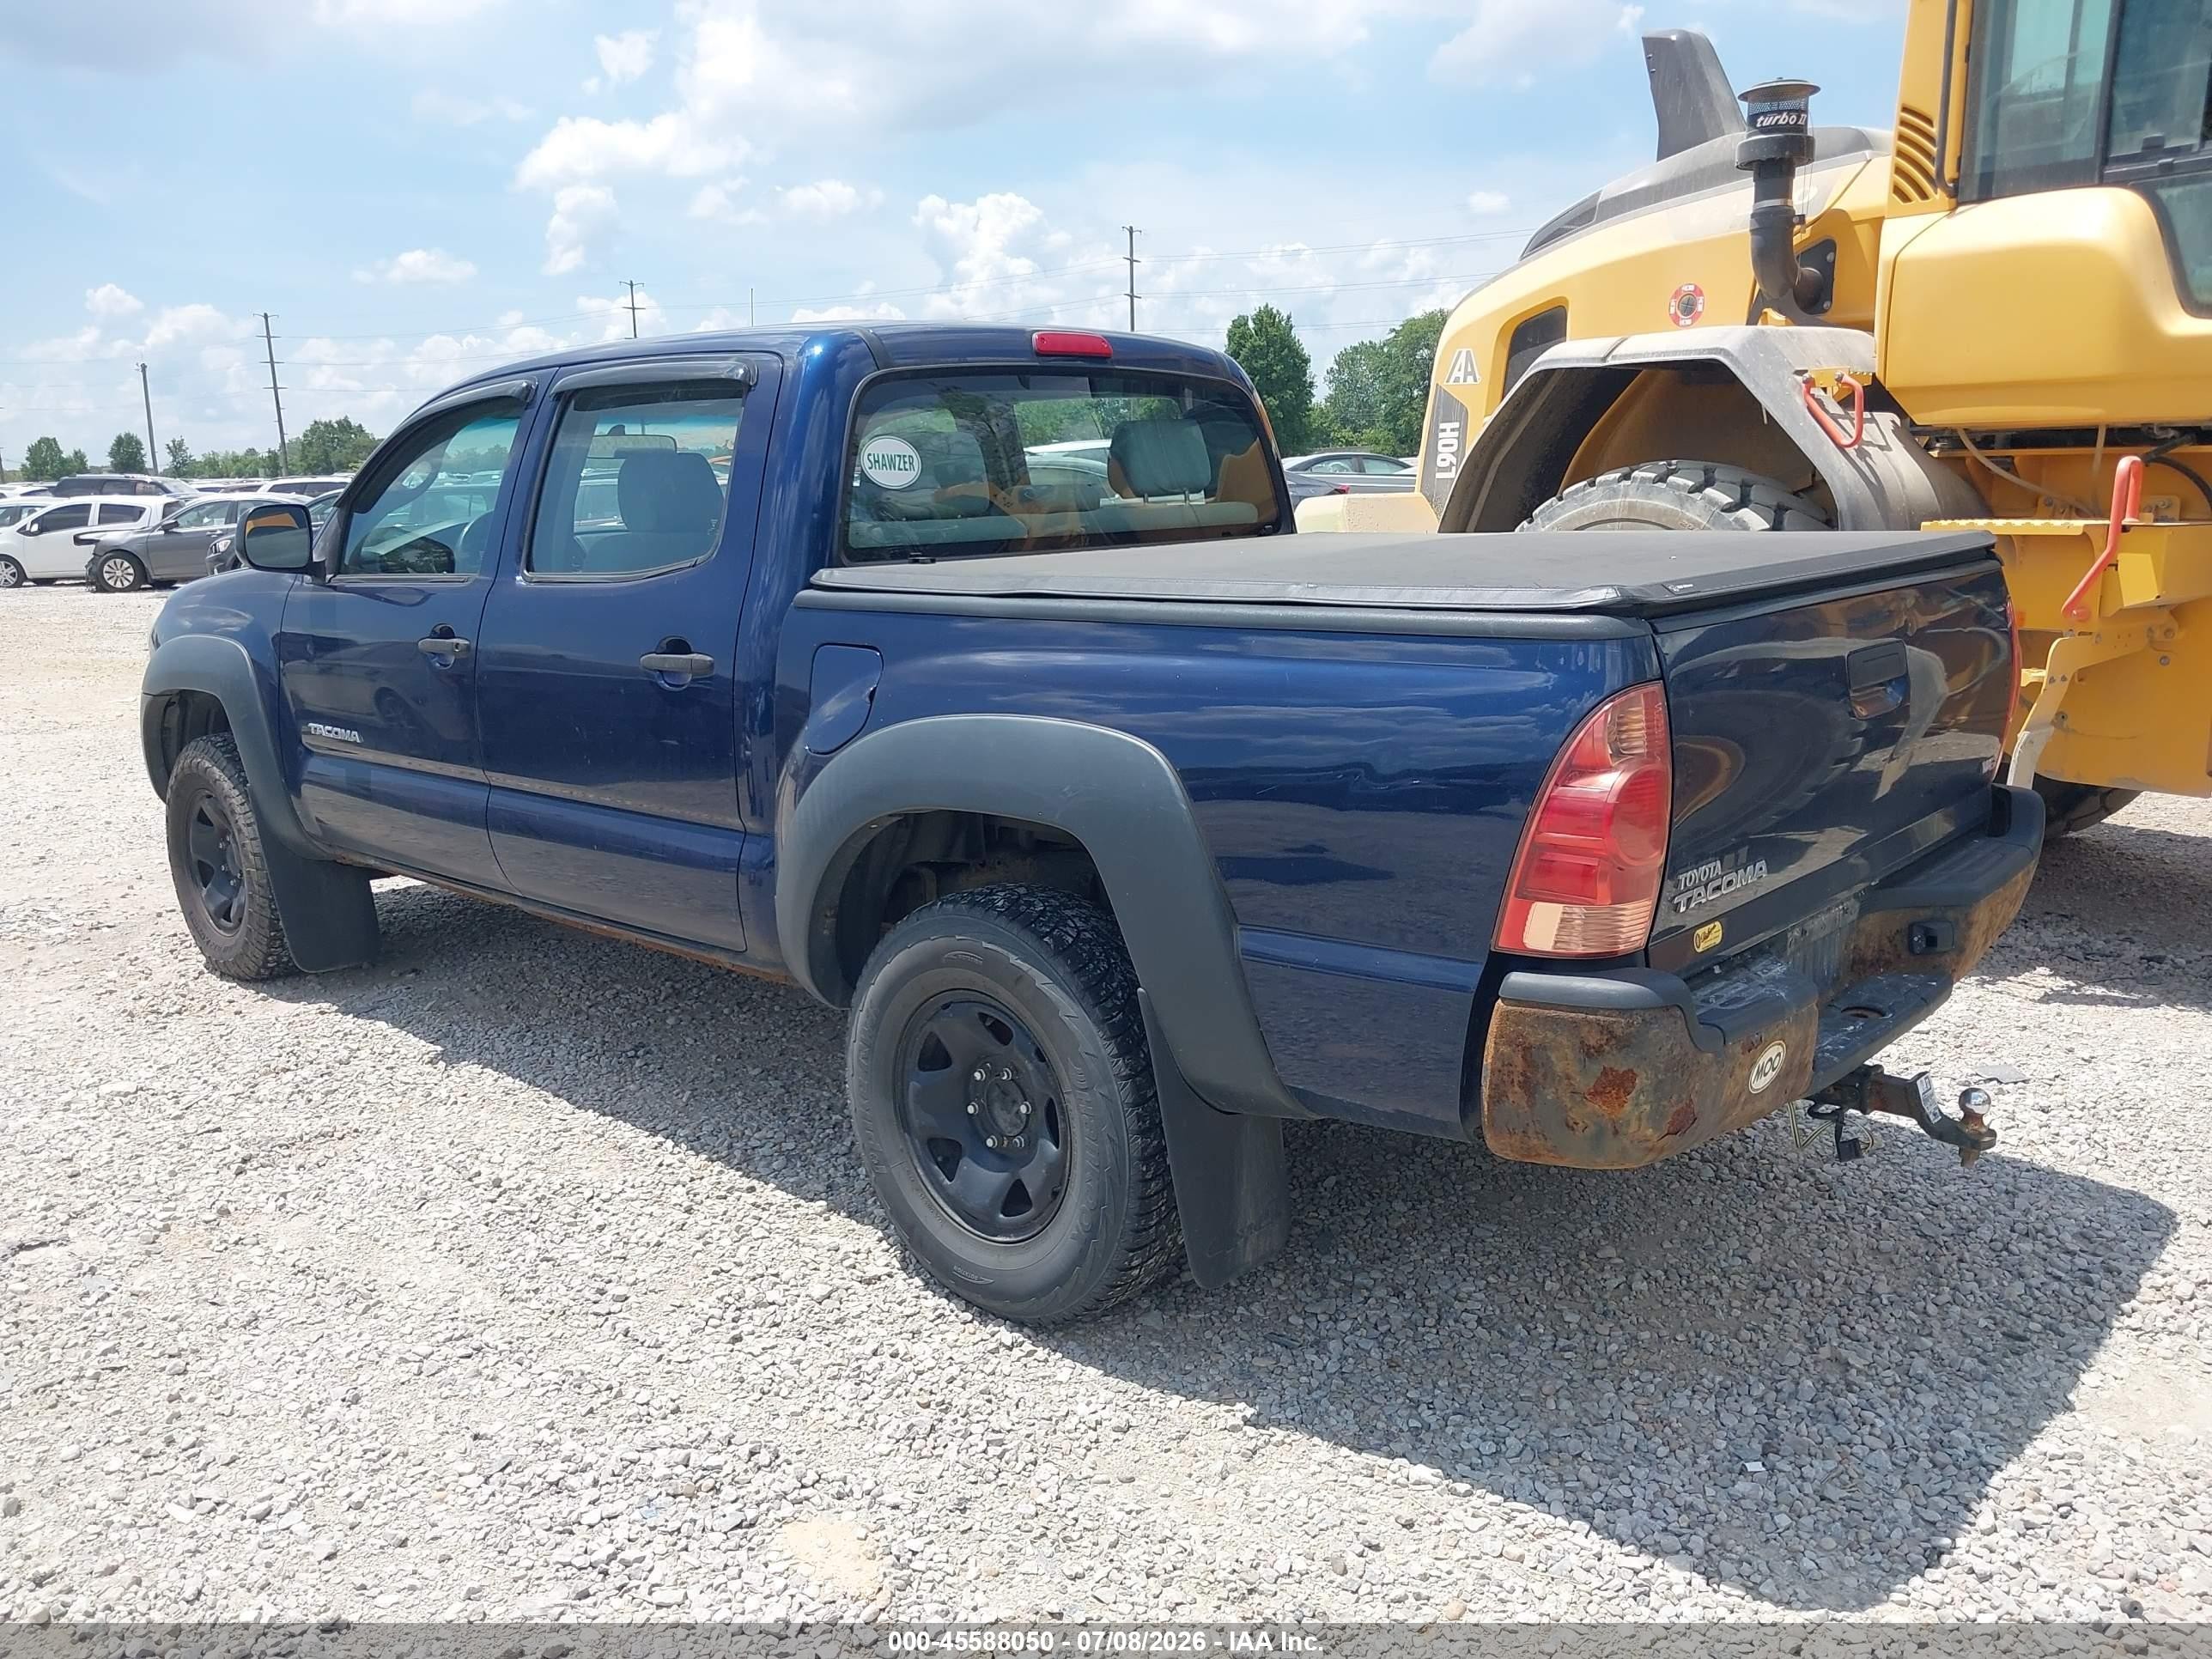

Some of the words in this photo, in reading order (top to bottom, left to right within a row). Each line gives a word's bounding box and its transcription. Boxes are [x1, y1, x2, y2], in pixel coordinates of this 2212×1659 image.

[1756, 112, 1796, 127] turbo
[866, 453, 915, 472] SHAWZER
[1435, 422, 1460, 479] L90H
[307, 722, 362, 744] TACOMA
[1674, 860, 1769, 913] TACOMA
[1678, 860, 1722, 890] TOYOTA
[1753, 1052, 1782, 1085] MOO
